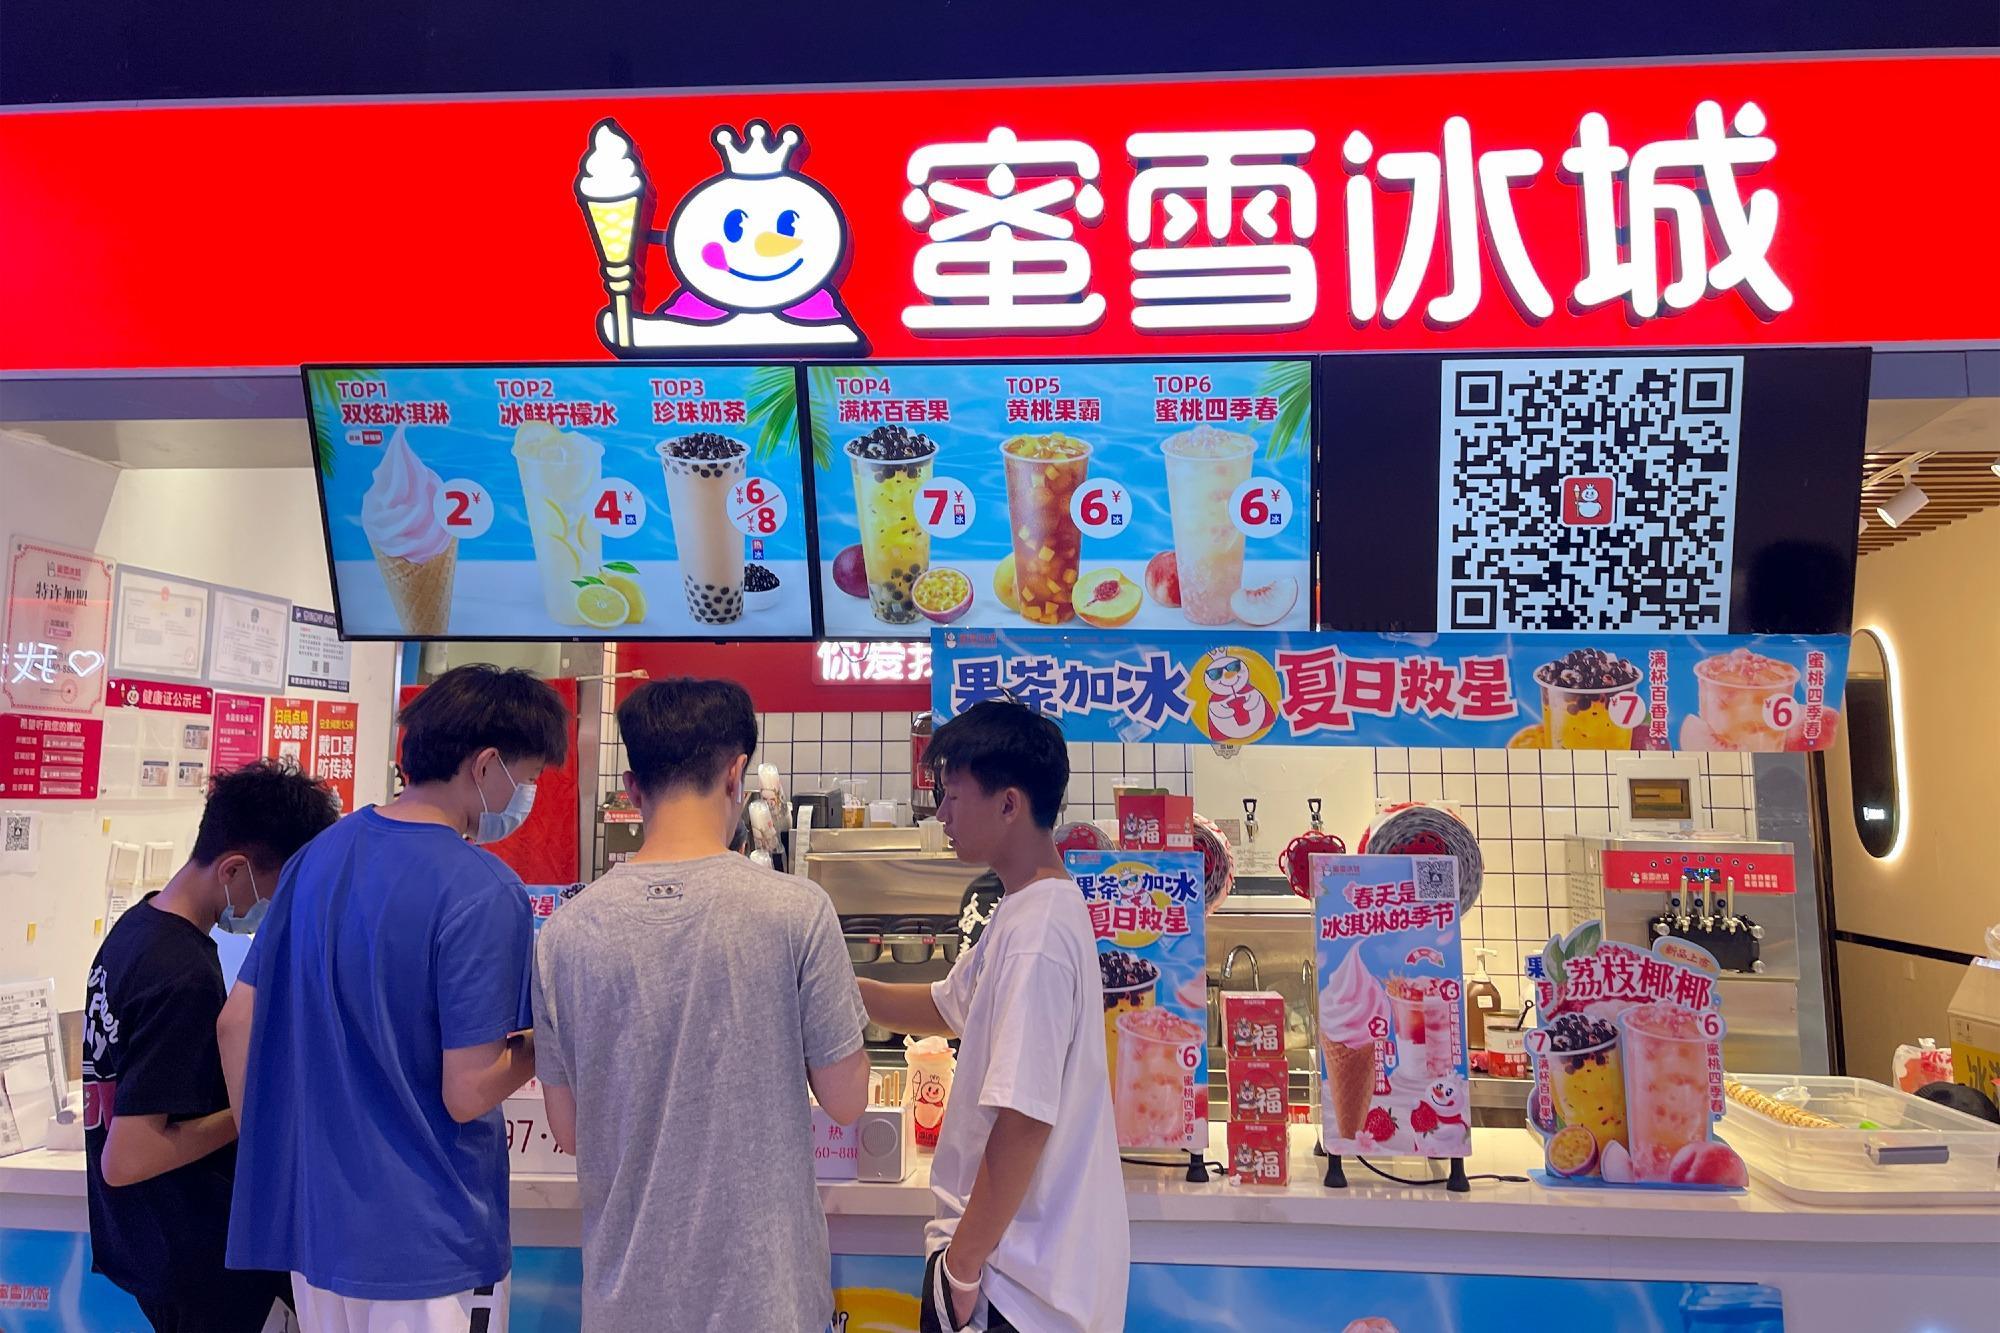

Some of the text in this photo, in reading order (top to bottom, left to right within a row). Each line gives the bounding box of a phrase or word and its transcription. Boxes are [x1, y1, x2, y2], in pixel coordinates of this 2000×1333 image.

[901, 100, 1796, 331] 蜜雪冰城
[337, 380, 388, 399] TOP1
[497, 380, 554, 399] TOP2
[651, 379, 704, 397] TOP3
[836, 377, 891, 395] TOP4
[1006, 377, 1060, 395] TOP5
[1154, 376, 1211, 394] TOP6
[342, 403, 450, 425] 双炫冰淇淋
[500, 403, 617, 426] 冰鲜柠檬水
[654, 401, 746, 424] 珍珠奶茶
[839, 400, 951, 423] 满杯百香果
[1007, 399, 1101, 422] 黄桃果霸
[1155, 398, 1279, 422] 蜜桃四季春
[36, 581, 88, 606] 特许加盟
[142, 688, 202, 709] 健康证公示栏
[955, 647, 1513, 734] 果茶加冰 夏日救星
[1650, 650, 1668, 738] 满杯百香果
[1805, 651, 1825, 738] 蜜桃四季春
[274, 709, 309, 725] 扫码点单
[318, 735, 354, 757] 戴口罩
[317, 757, 353, 780] 防传染
[1139, 818, 1160, 844] 福
[1076, 871, 1198, 901] 果茶加冰
[1354, 881, 1417, 910] 春天是
[1087, 902, 1190, 939] 夏日救星
[1322, 902, 1455, 940] 冰淇淋的季节
[1566, 955, 1712, 1011] 荔枝椰椰
[1253, 1023, 1278, 1050] 福
[1706, 1043, 1723, 1112] 蜜桃四季春
[1183, 1075, 1195, 1135] 蜜桃四季春
[1257, 1087, 1282, 1114] 福
[1255, 1151, 1280, 1178] 福
